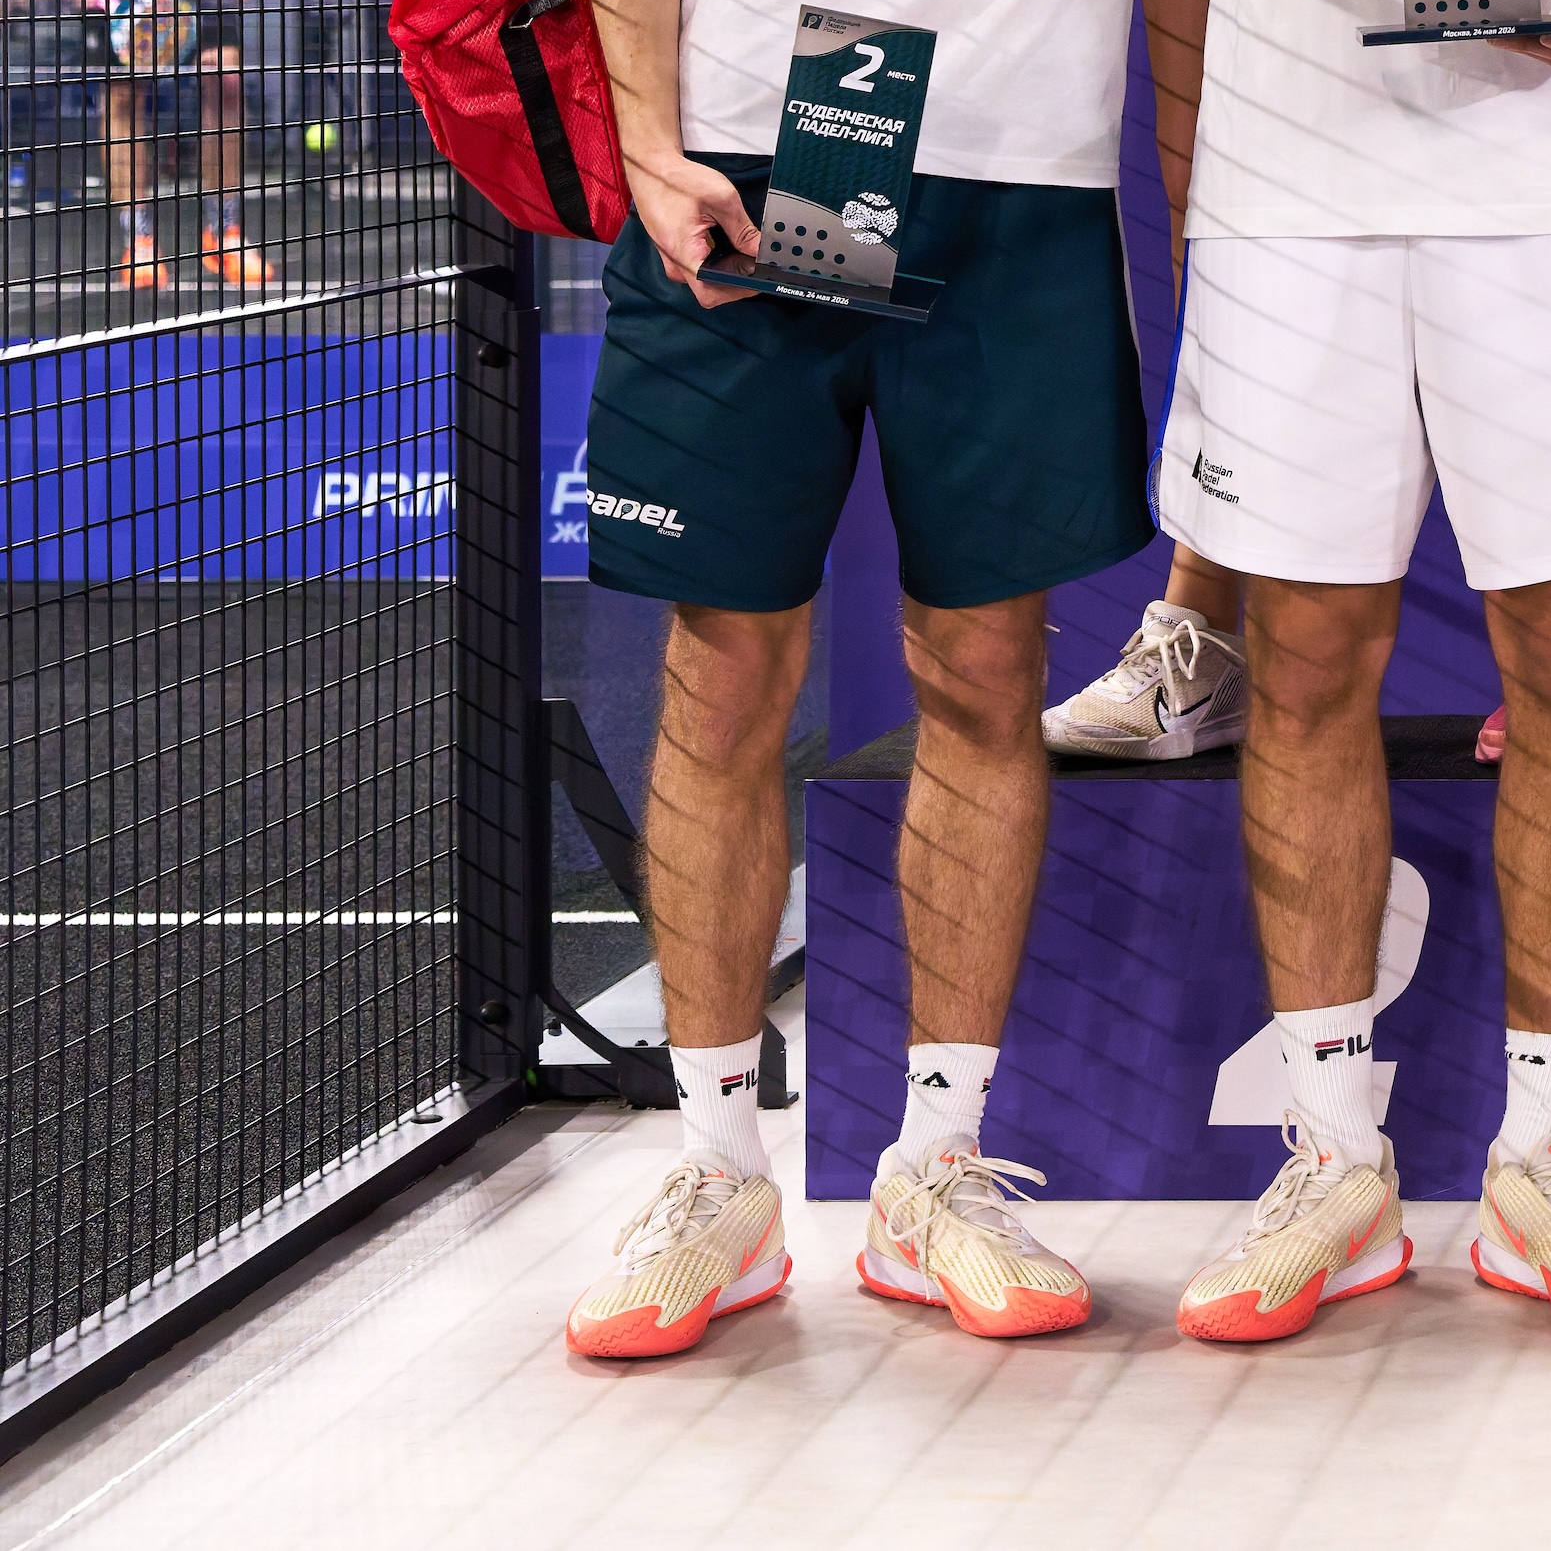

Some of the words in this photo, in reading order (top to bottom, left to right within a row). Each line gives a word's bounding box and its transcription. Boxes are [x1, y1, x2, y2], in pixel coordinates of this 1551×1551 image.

[1442, 28, 1472, 37] Москва,
[1472, 28, 1482, 36] 24
[1483, 27, 1498, 36] мая
[1498, 27, 1516, 35] 2026
[838, 42, 886, 93] 2
[887, 69, 916, 83] место
[786, 99, 905, 134] СТУДЕНЧЕСКАЯ
[795, 117, 895, 148] ПАДЕЛ-ЛИГА
[776, 285, 806, 298] Москва,
[806, 290, 816, 299] 24
[816, 292, 831, 302] мая
[831, 294, 850, 305] 2026
[1202, 470, 1220, 486] Padel
[1204, 459, 1233, 478] Russian
[657, 527, 682, 538] Russia
[1314, 1034, 1373, 1062] FIL
[720, 1068, 760, 1095] FIL
